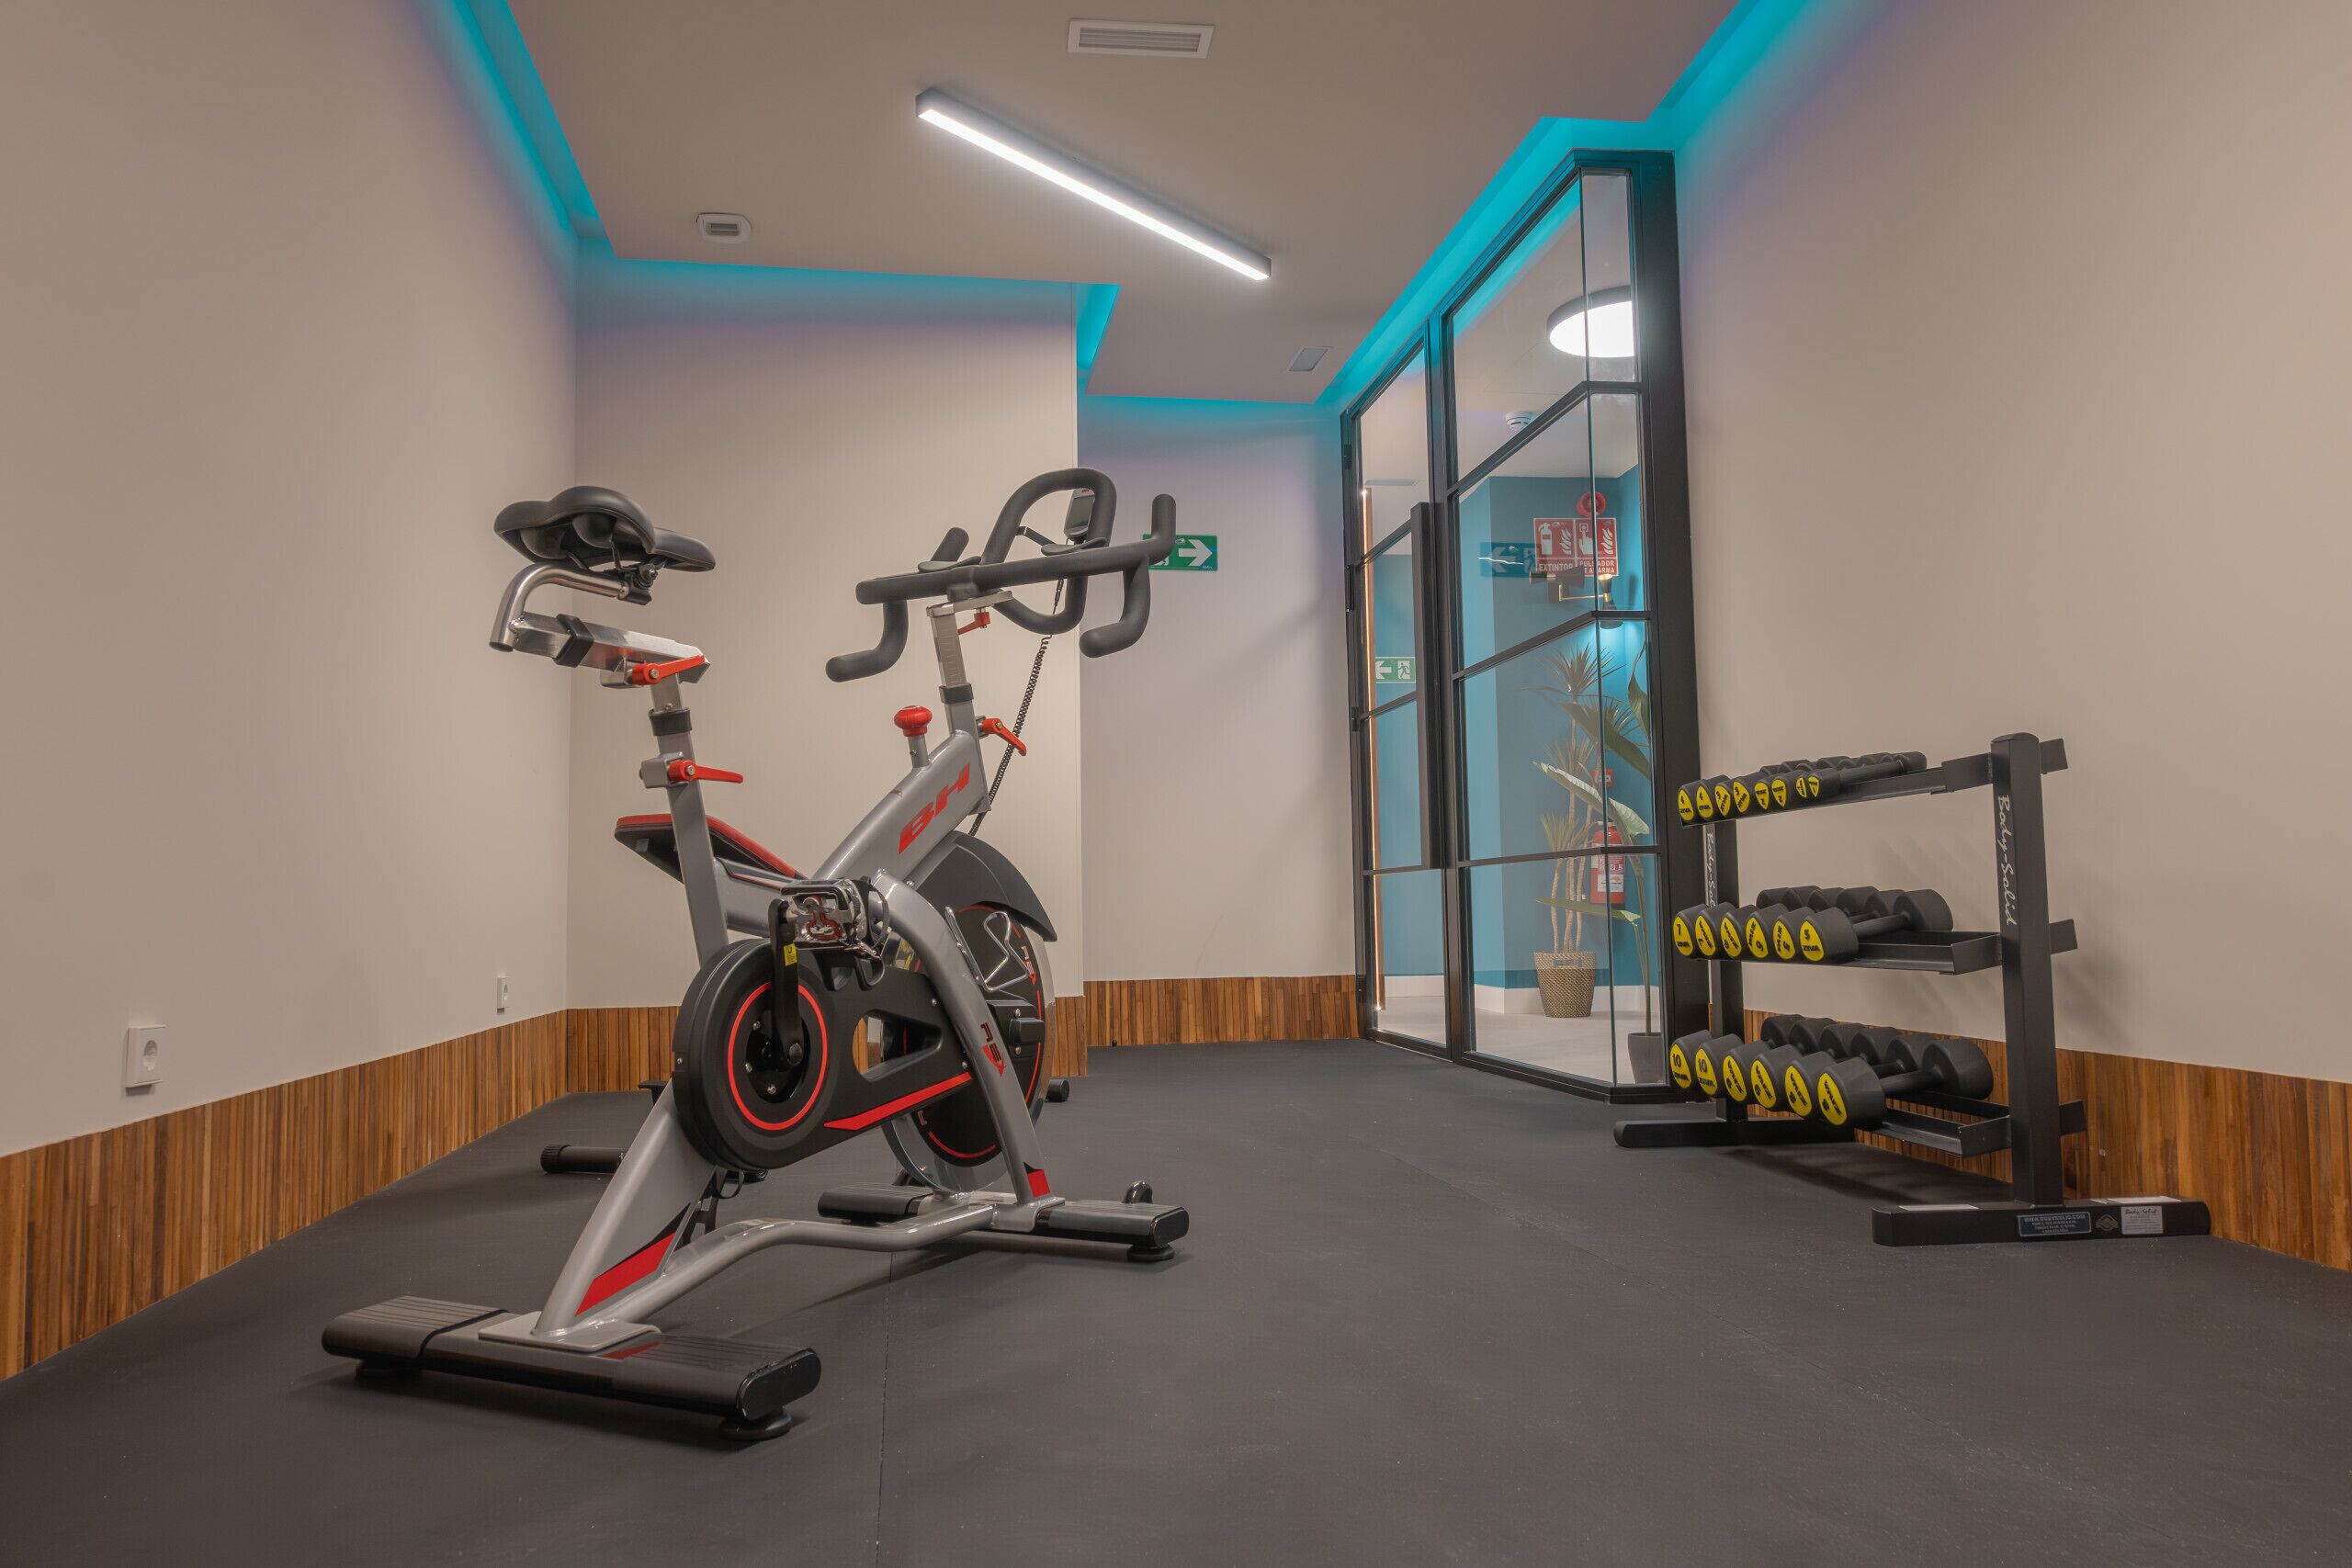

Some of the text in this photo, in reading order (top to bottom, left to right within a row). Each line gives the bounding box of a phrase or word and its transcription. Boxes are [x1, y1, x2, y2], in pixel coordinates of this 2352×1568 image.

[898, 761, 971, 854] BH
[1707, 832, 1717, 908] Body-Sol
[1997, 795, 2018, 926] Body-Solid
